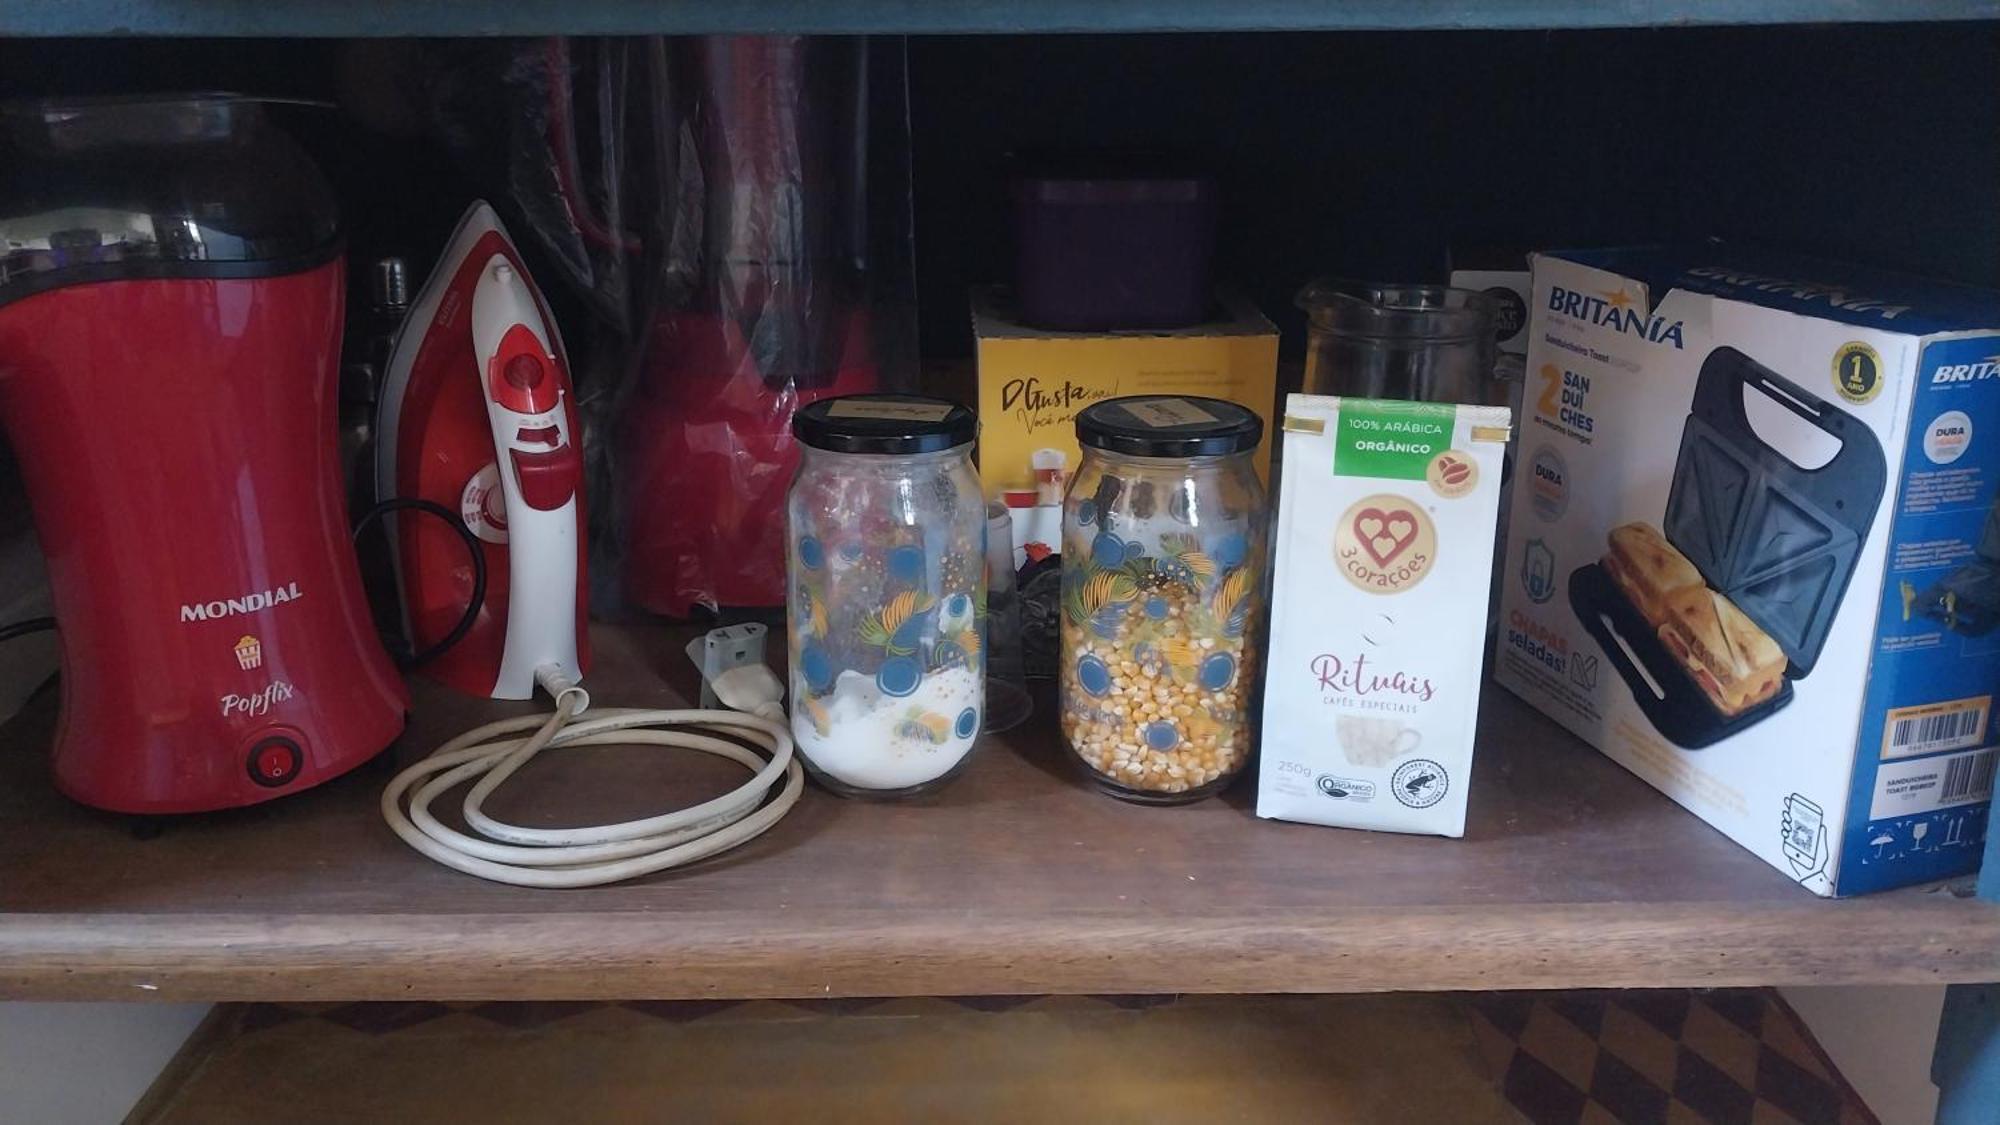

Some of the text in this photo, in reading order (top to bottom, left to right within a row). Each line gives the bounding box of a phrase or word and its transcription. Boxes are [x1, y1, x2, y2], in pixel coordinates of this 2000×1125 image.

[1563, 371, 1590, 395] SAN
[1849, 355, 1863, 384] 1
[1538, 363, 1562, 417] 2
[1562, 388, 1584, 412] DUI
[1349, 418, 1443, 435] 100% ARÁBICA
[1559, 407, 1594, 434] CHES
[1935, 426, 1966, 437] DURA
[1355, 439, 1430, 455] ORGÂNICO
[1535, 463, 1563, 486] DURA
[1341, 545, 1428, 588] 3 corações
[180, 582, 303, 622] MONDIAL
[1509, 610, 1569, 655] CHAPAS
[1508, 628, 1567, 674] seladas!
[1310, 653, 1438, 702] Rituais
[220, 680, 294, 717] Popflix
[1323, 695, 1418, 714] CAFÉS ESPECIAIS
[1277, 760, 1312, 778] 250g
